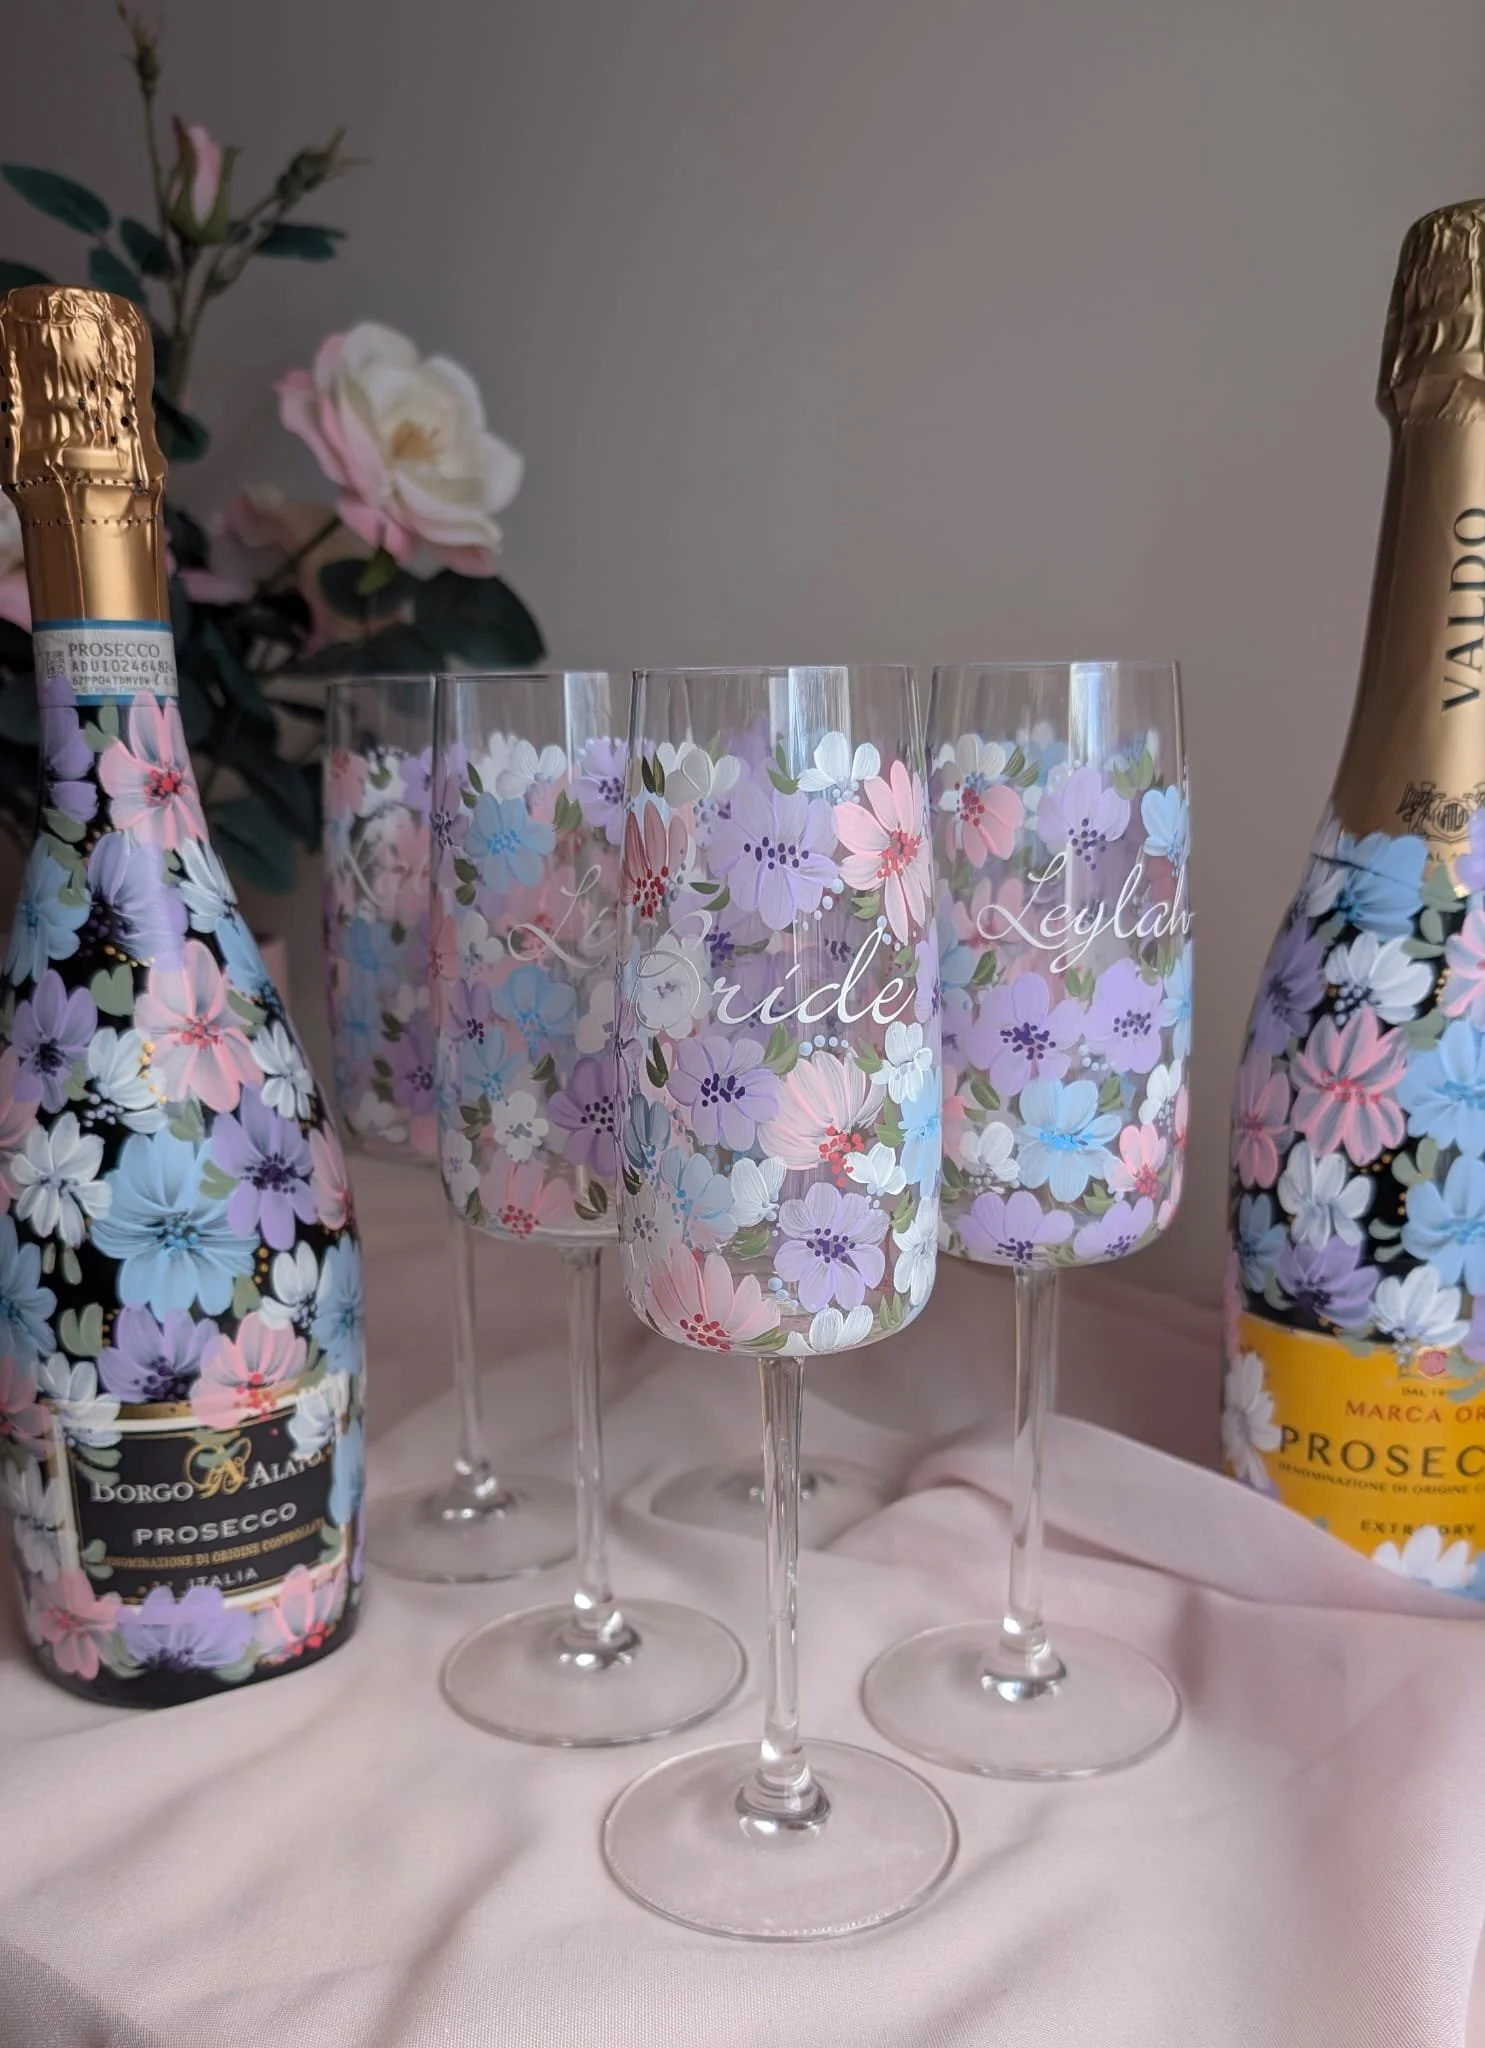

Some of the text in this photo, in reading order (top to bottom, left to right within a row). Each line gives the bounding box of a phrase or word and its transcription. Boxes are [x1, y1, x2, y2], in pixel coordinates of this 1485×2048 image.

[1441, 508, 1485, 713] VALDO
[68, 643, 161, 657] PROSECCO
[626, 909, 918, 1032] Bride
[1345, 1400, 1442, 1424] MARCA
[1279, 1424, 1485, 1479] PROSEC
[1412, 1484, 1468, 1495] ORIGINE
[132, 1501, 298, 1548] PROSECCO
[1360, 1518, 1417, 1537] EXTR
